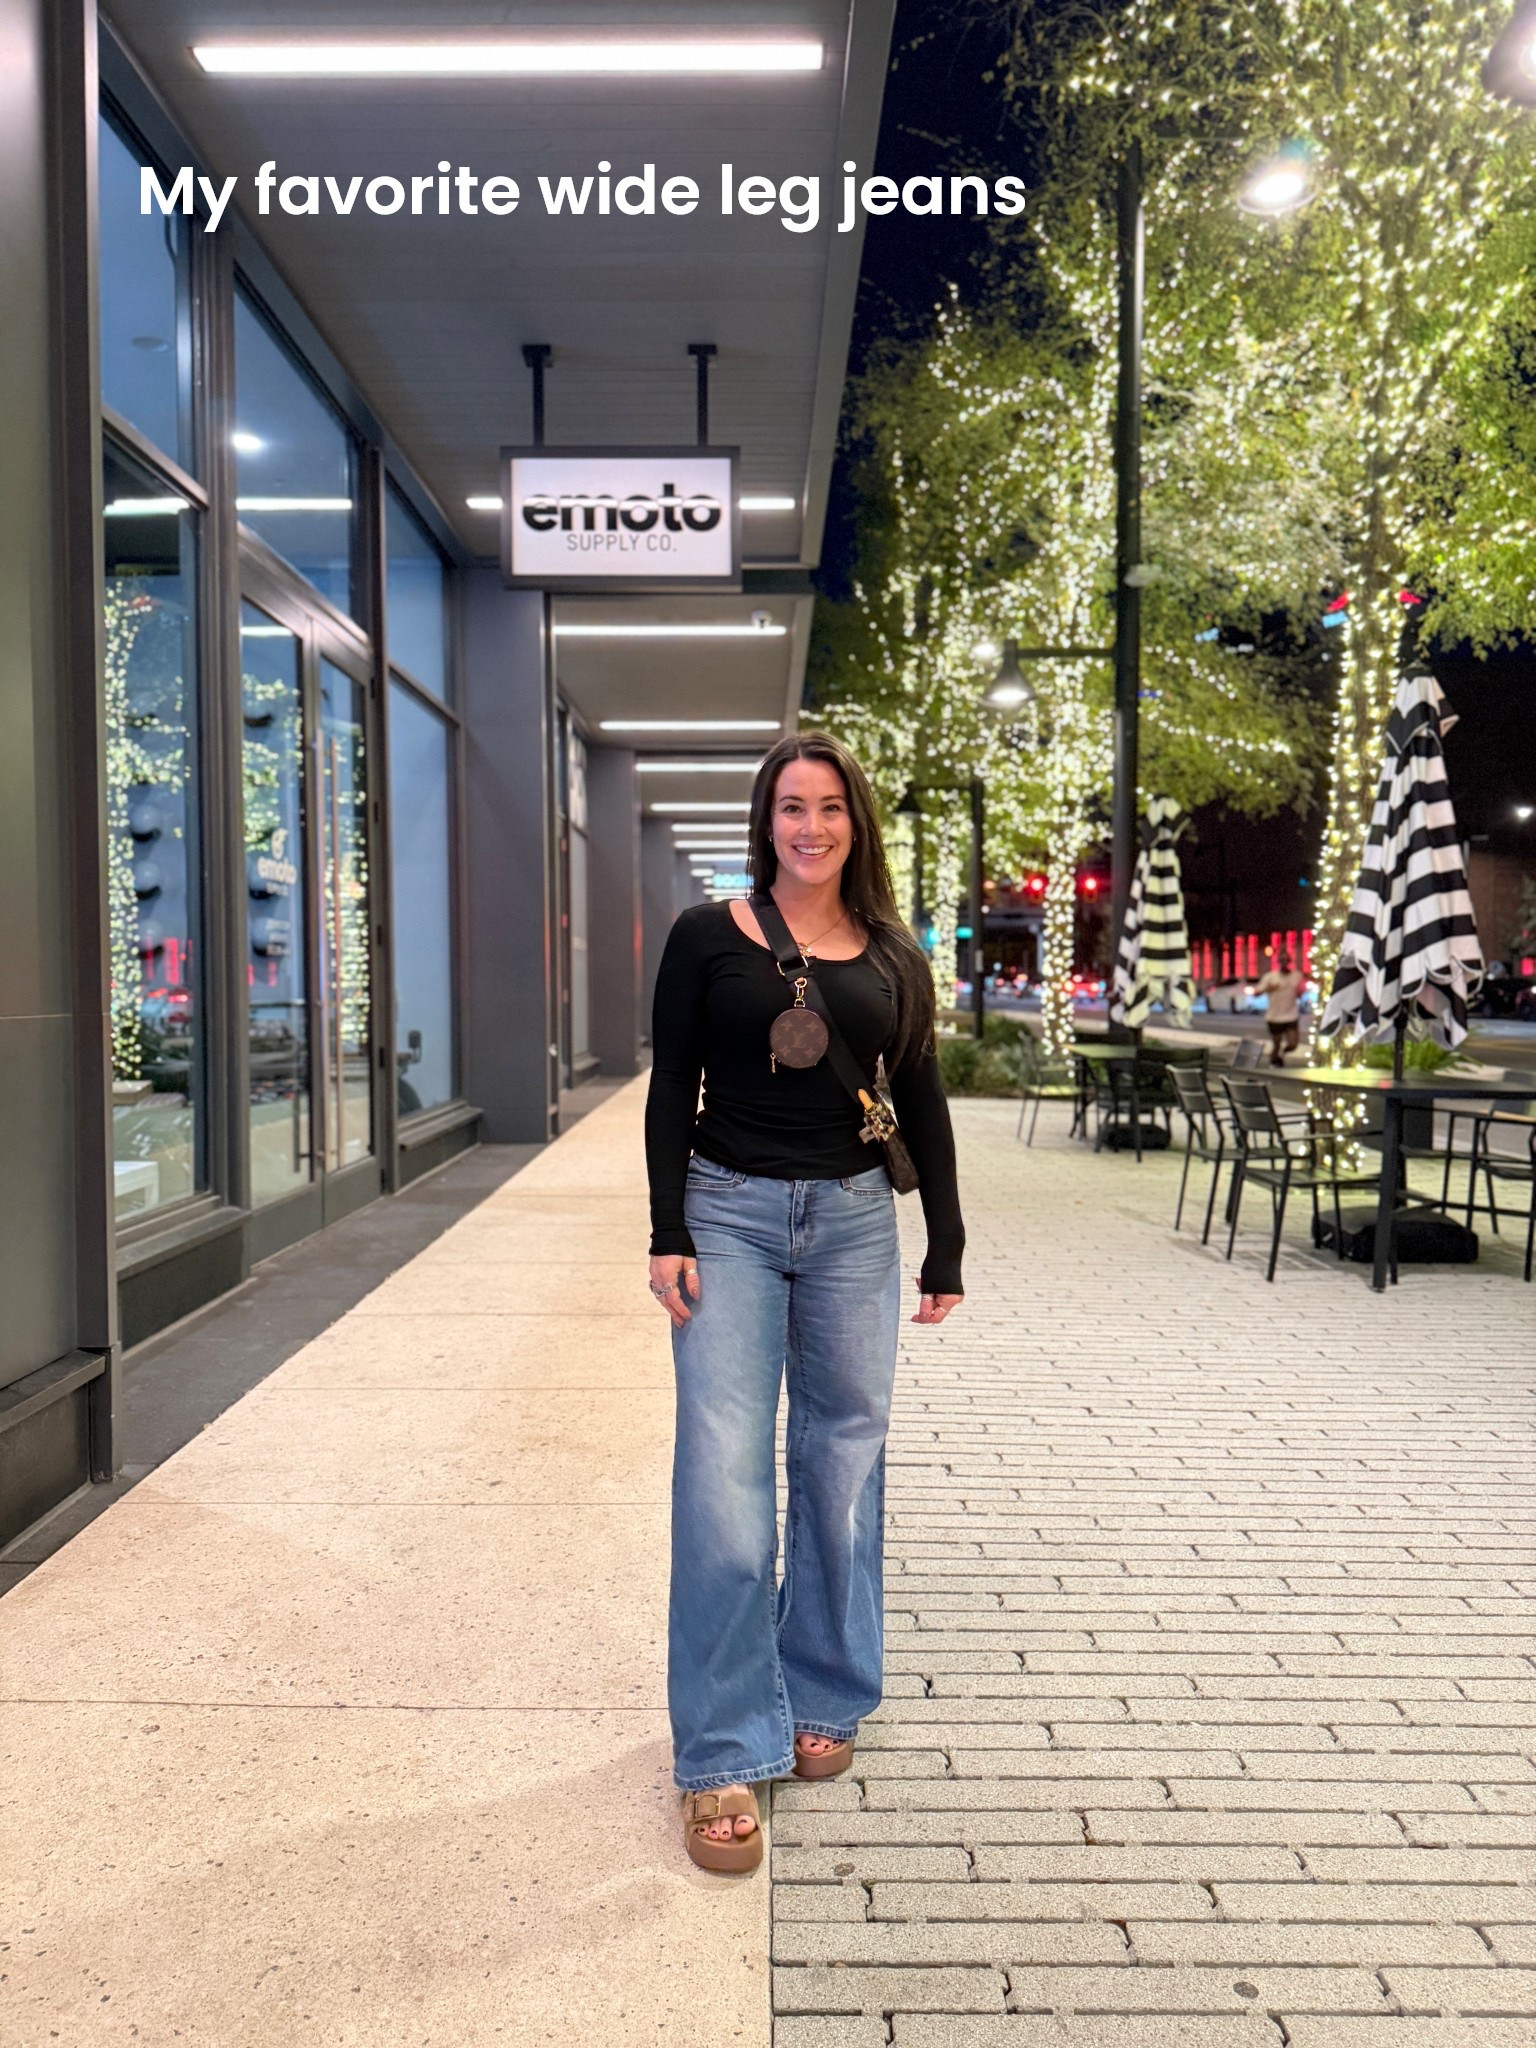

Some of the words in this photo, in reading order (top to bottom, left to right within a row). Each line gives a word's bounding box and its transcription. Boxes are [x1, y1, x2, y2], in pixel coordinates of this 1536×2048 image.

[522, 483, 722, 532] emoto
[566, 533, 640, 551] SUPPLY
[646, 533, 677, 552] CO.
